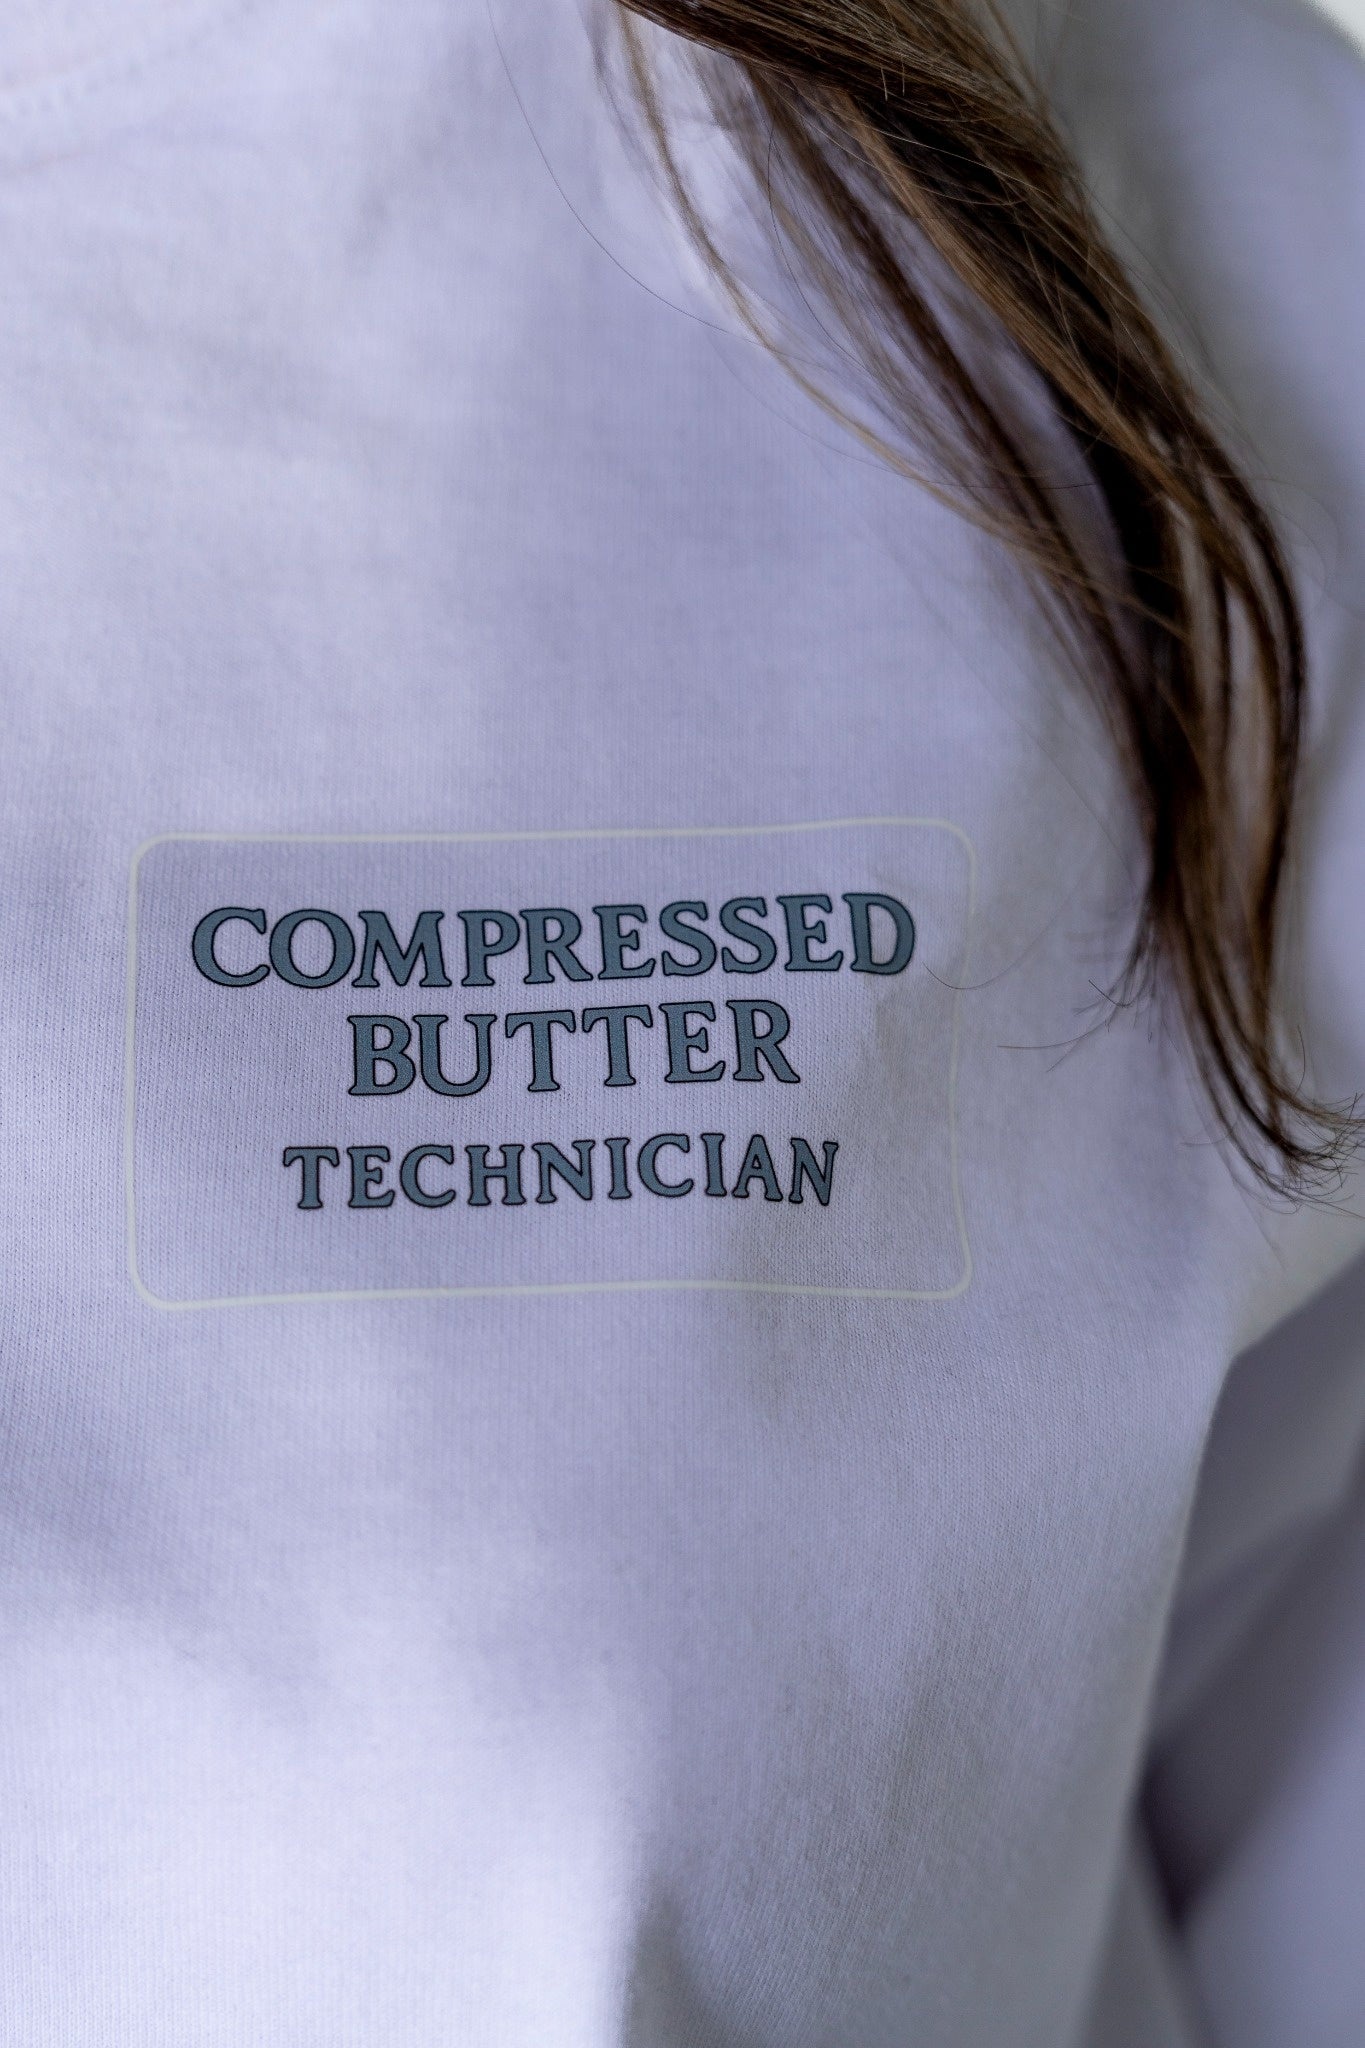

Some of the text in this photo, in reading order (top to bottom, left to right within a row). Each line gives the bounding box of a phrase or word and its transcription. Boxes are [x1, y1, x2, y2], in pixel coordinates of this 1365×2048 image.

[191, 892, 917, 989] COMPRESSED
[346, 999, 801, 1098] BUTTER
[282, 1131, 840, 1211] TECHNICIAN
